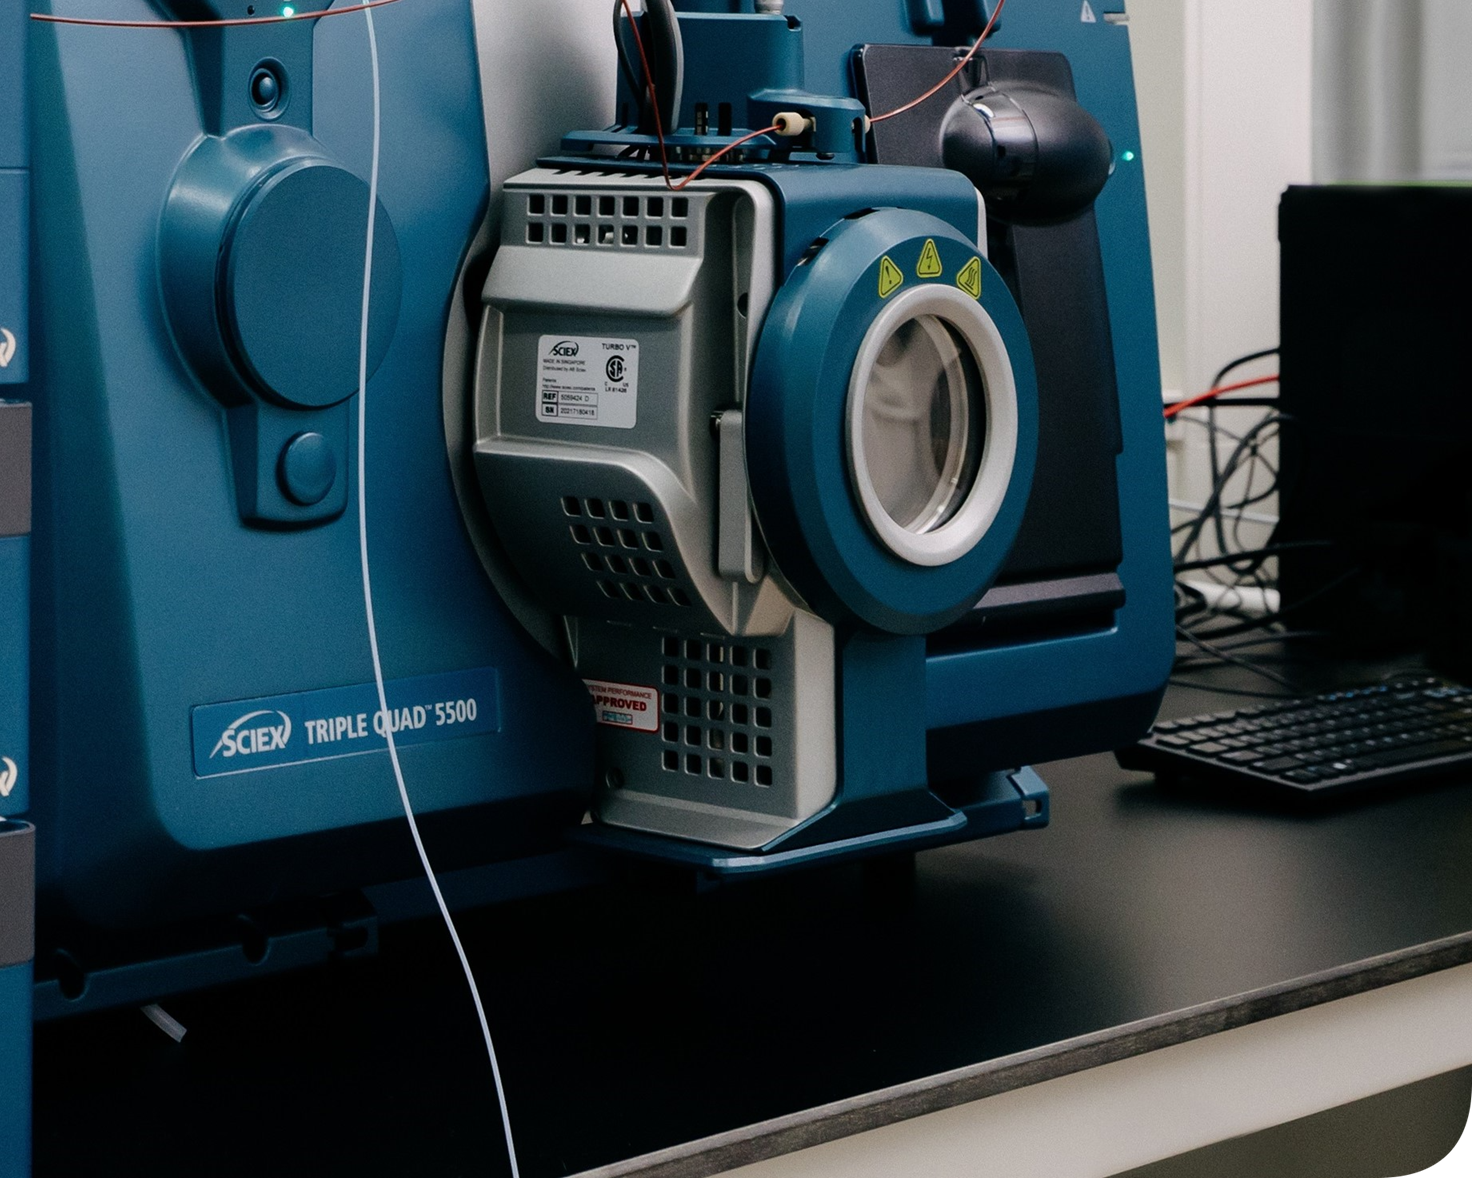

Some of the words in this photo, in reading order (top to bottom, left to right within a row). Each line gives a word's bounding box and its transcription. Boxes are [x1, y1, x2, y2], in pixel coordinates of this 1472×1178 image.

[551, 344, 577, 357] SCIEX
[608, 687, 652, 699] PERFORMANCE
[216, 717, 289, 757] SCIEX
[304, 714, 369, 744] TRIPLE
[435, 698, 477, 725] 5500
